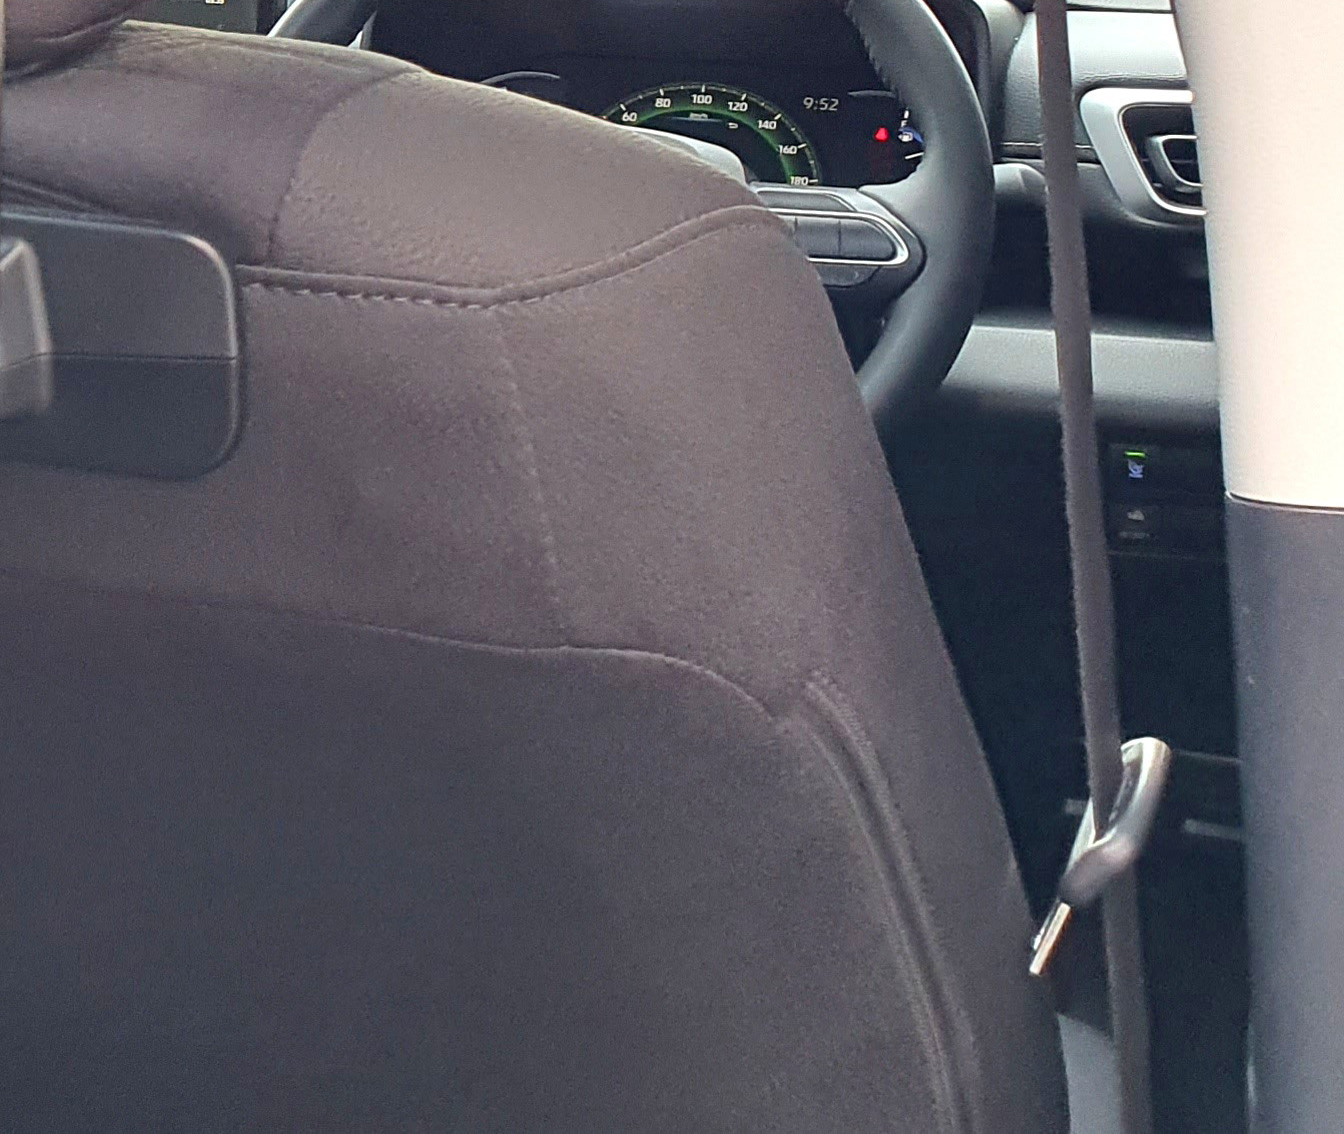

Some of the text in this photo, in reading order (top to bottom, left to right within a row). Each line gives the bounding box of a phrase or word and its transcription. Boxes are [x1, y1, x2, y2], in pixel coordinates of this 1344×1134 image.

[655, 97, 671, 108] 80
[692, 94, 712, 105] 100
[803, 97, 839, 111] 9:52
[728, 101, 748, 112] 120
[622, 112, 637, 123] 60
[757, 119, 777, 130] 140
[779, 144, 797, 155] 160
[790, 176, 808, 186] 180
